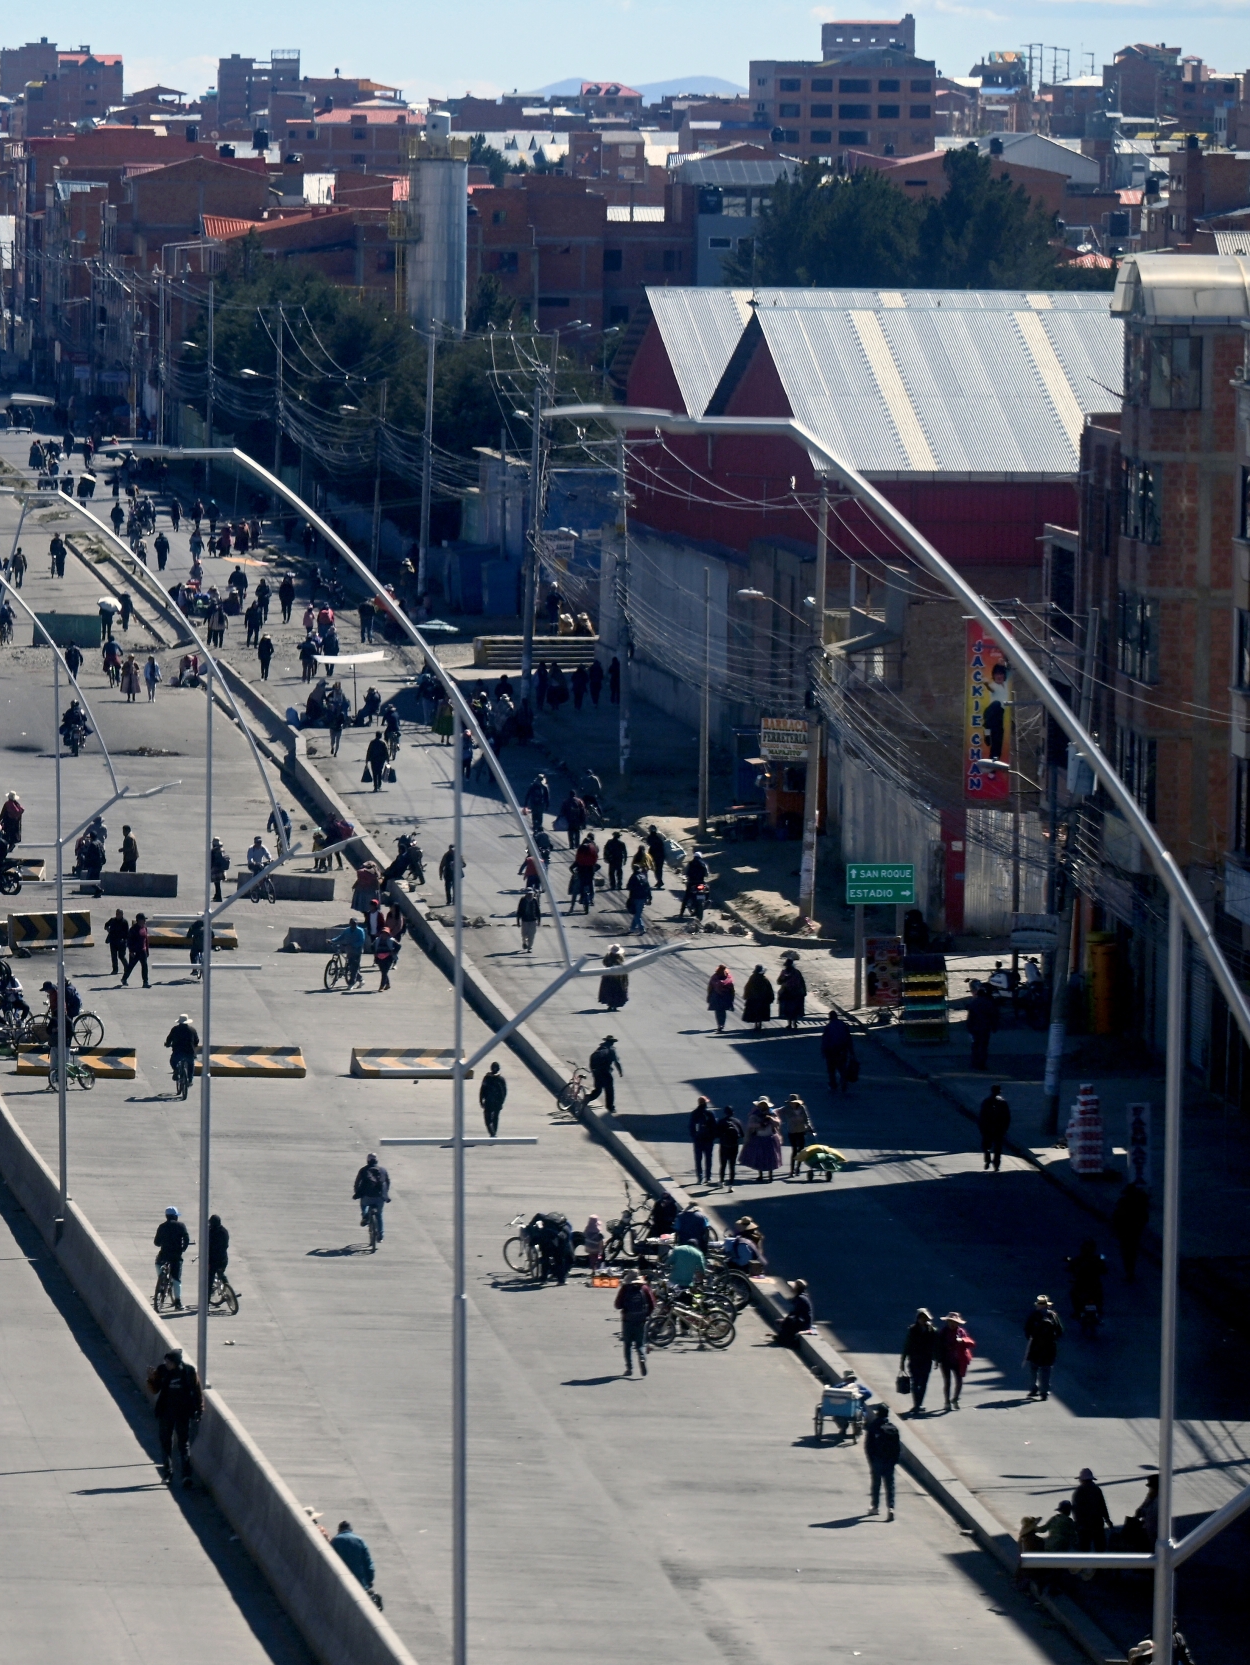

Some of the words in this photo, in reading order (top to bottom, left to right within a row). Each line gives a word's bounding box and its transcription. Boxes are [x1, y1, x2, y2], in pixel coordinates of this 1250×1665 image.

[970, 639, 985, 728] JACKIE
[763, 718, 808, 732] BARRACA
[968, 733, 983, 790] CHAN
[859, 869, 879, 878] SAN
[880, 869, 912, 878] ROQUE
[849, 889, 894, 898] ESTADIO
